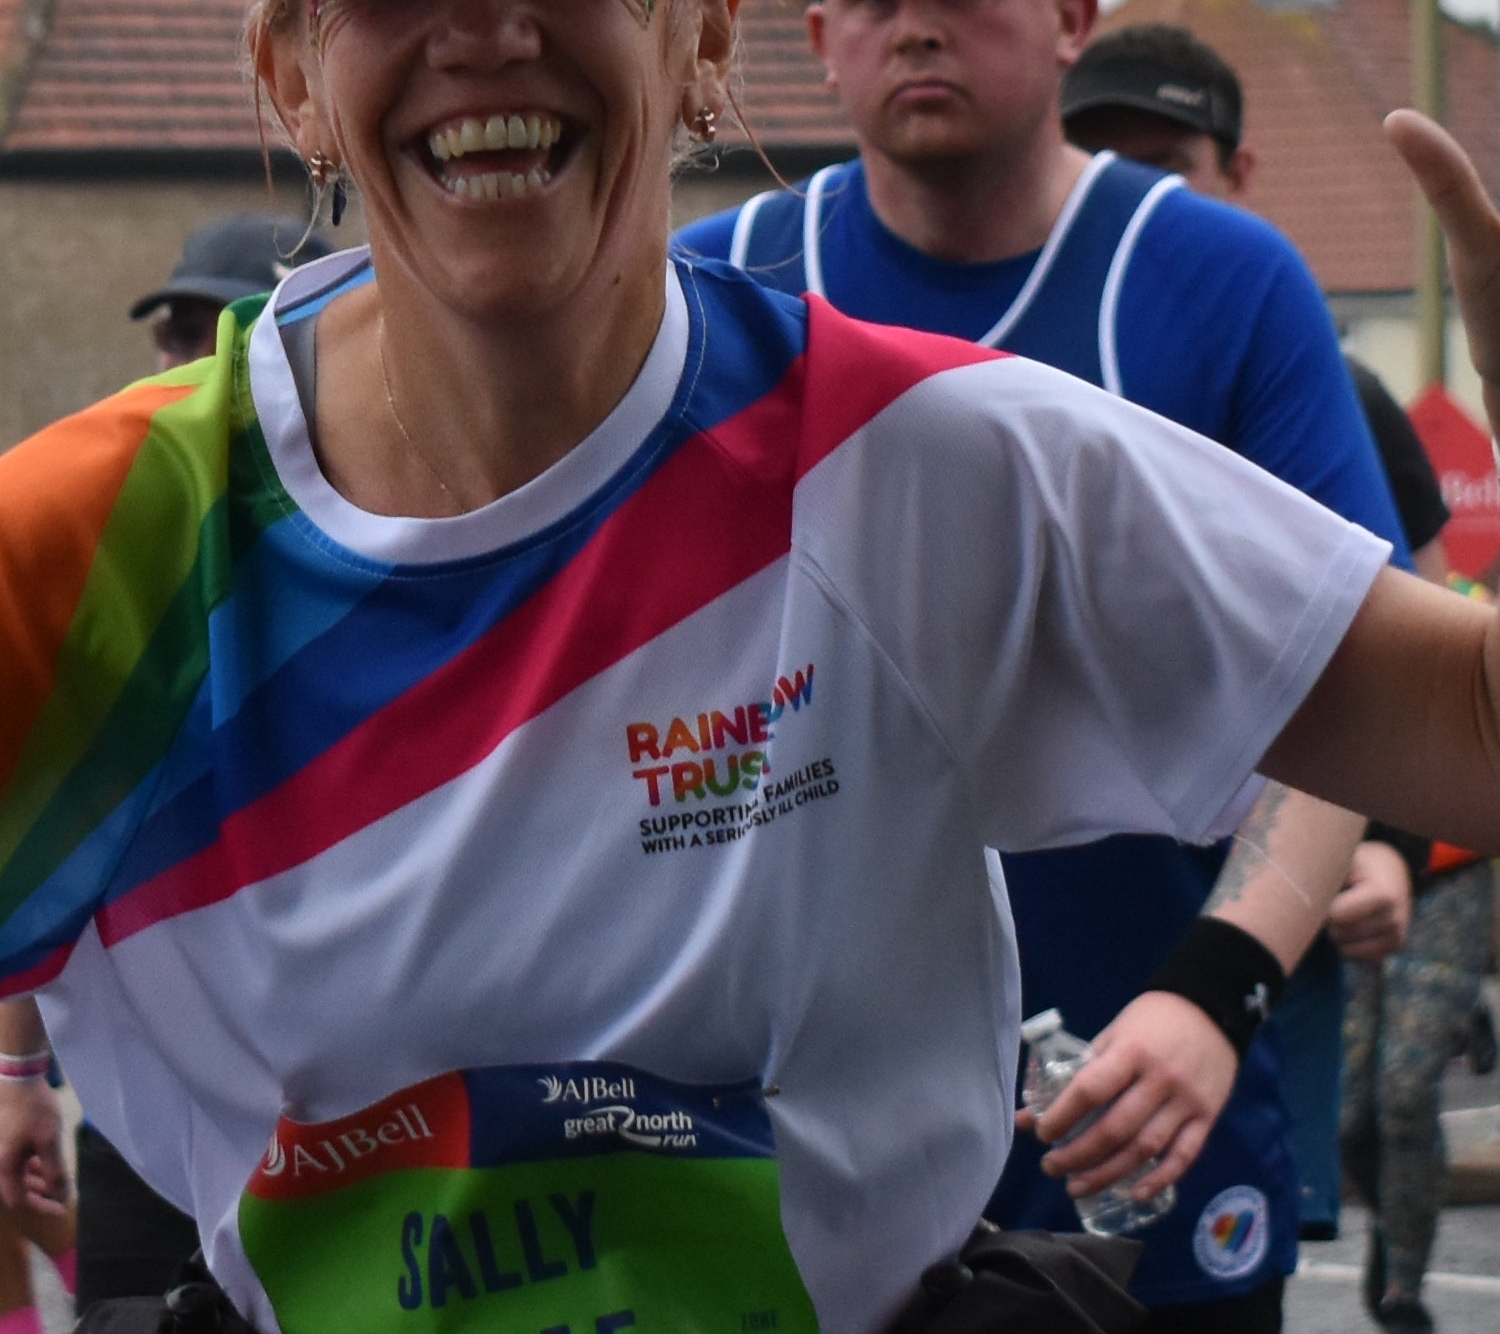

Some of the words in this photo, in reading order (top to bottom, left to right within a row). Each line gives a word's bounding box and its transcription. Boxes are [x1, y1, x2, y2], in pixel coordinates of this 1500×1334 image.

[763, 758, 836, 803] FAMILIES
[641, 835, 685, 855] WITH
[689, 834, 703, 848] A
[795, 779, 840, 808] CHILD
[562, 1076, 636, 1104] AJBell
[292, 1103, 434, 1177] AJBell
[563, 1113, 617, 1140] great
[636, 1111, 693, 1131] north
[660, 1133, 697, 1147] run
[397, 1190, 599, 1311] SALLY
